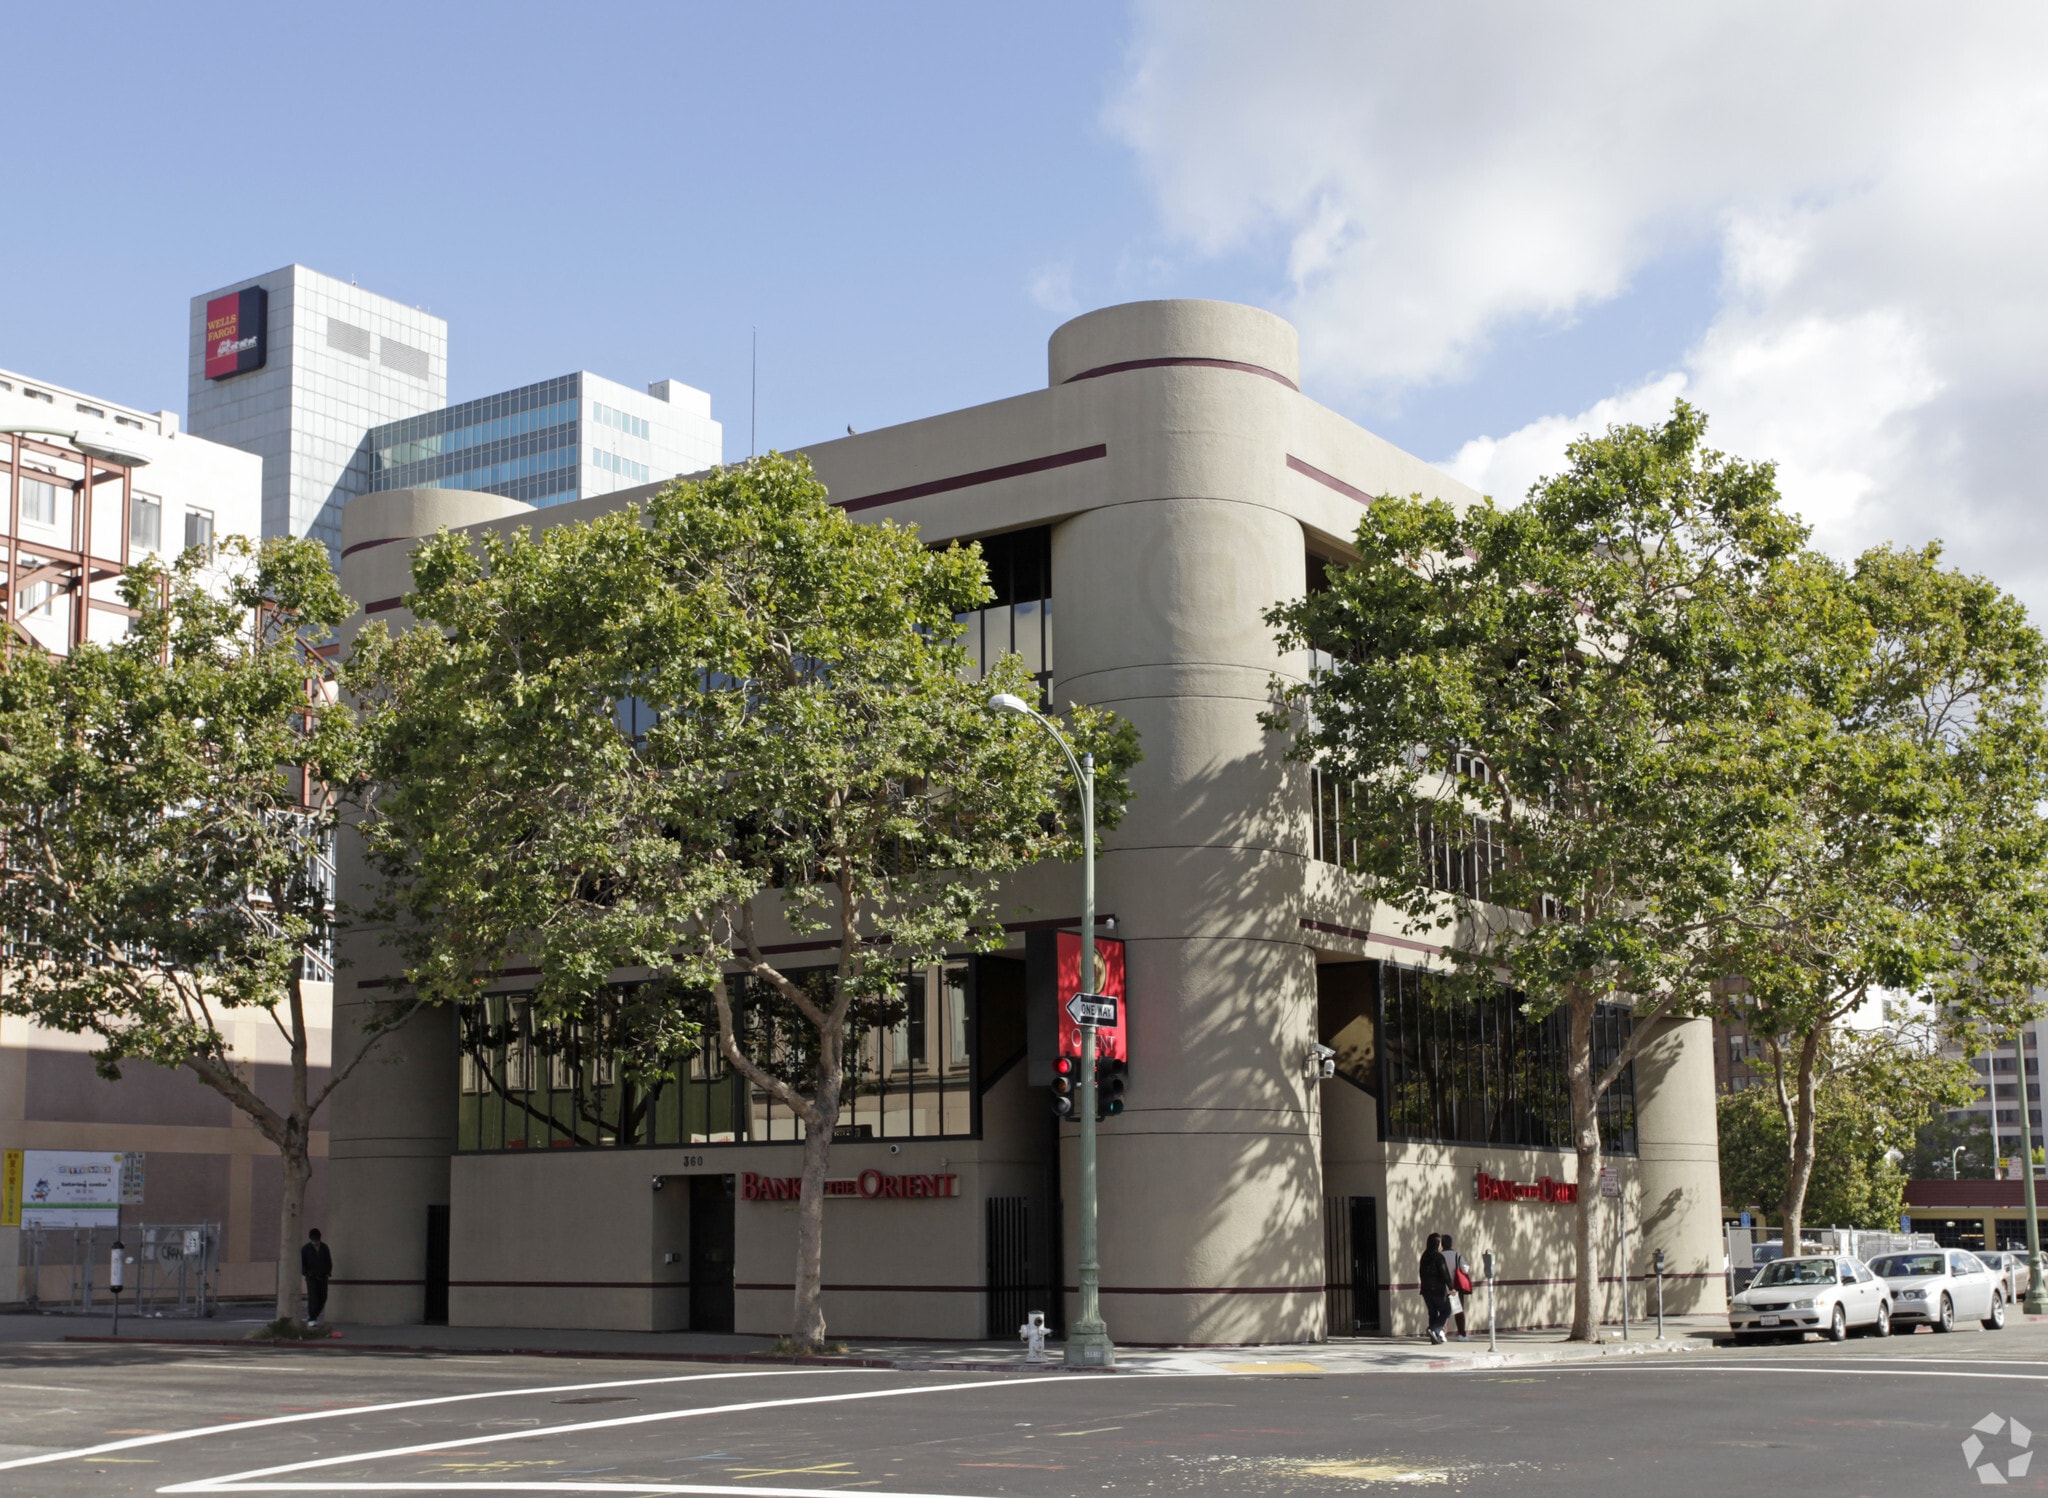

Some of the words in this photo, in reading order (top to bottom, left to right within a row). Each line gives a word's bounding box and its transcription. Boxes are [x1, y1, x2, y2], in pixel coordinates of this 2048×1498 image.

[207, 314, 237, 330] WELLS
[207, 326, 236, 341] FARGO
[1081, 1003, 1096, 1016] ONE
[1097, 1006, 1112, 1018] WAY
[1071, 1027, 1116, 1051] OENT
[683, 1156, 703, 1167] 360
[741, 1172, 801, 1201] BANK
[826, 1181, 857, 1196] THE
[857, 1169, 958, 1199] ORIENT
[1477, 1172, 1515, 1202] BANK
[1540, 1176, 1578, 1203] ORIEN
